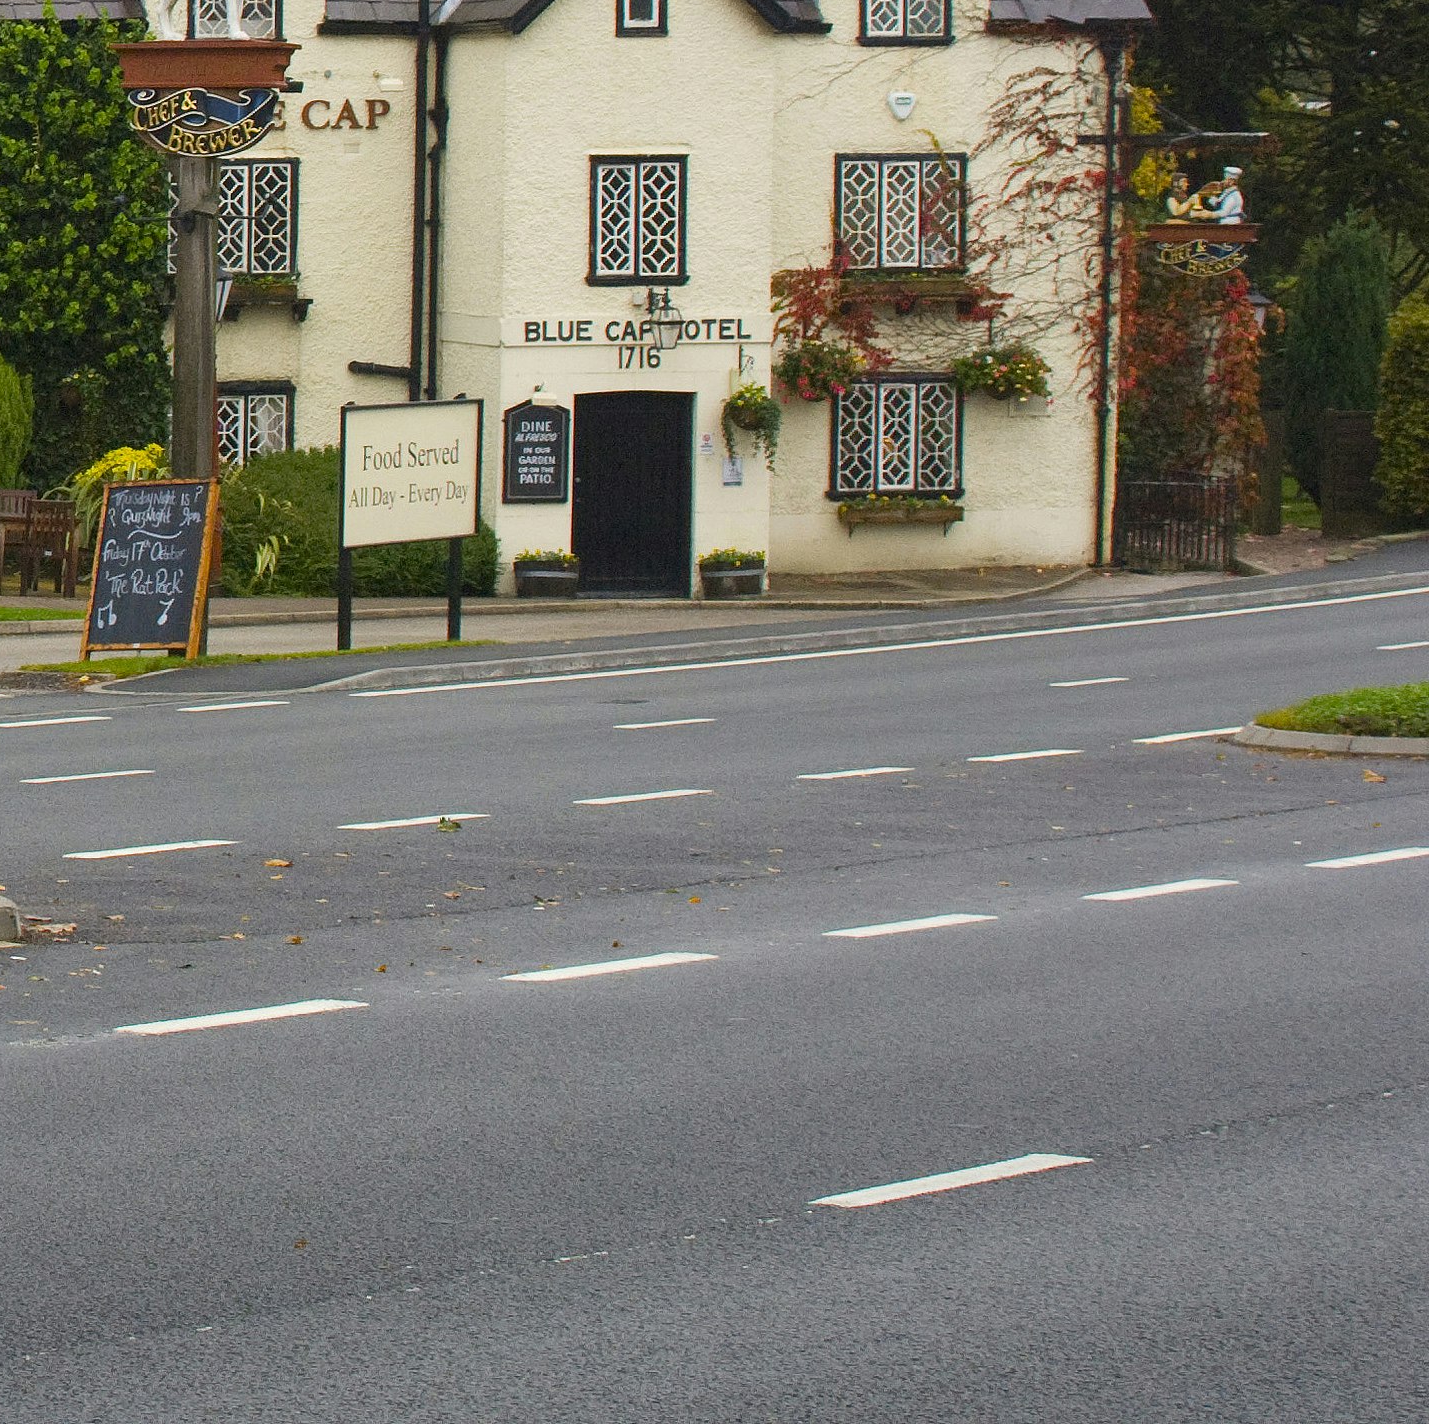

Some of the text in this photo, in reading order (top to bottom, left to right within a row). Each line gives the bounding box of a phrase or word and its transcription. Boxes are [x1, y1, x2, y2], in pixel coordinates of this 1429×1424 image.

[133, 91, 197, 130] CHEF &
[301, 98, 390, 130] CAP
[167, 118, 262, 154] BREWER
[524, 320, 592, 343] BLUE
[618, 346, 662, 369] 1716
[521, 421, 552, 432] DINE
[363, 438, 459, 471] Food Served
[518, 456, 556, 465] GARDEN
[349, 487, 368, 508] All
[372, 487, 395, 510] Day
[408, 483, 441, 506] Every
[445, 480, 468, 505] Day
